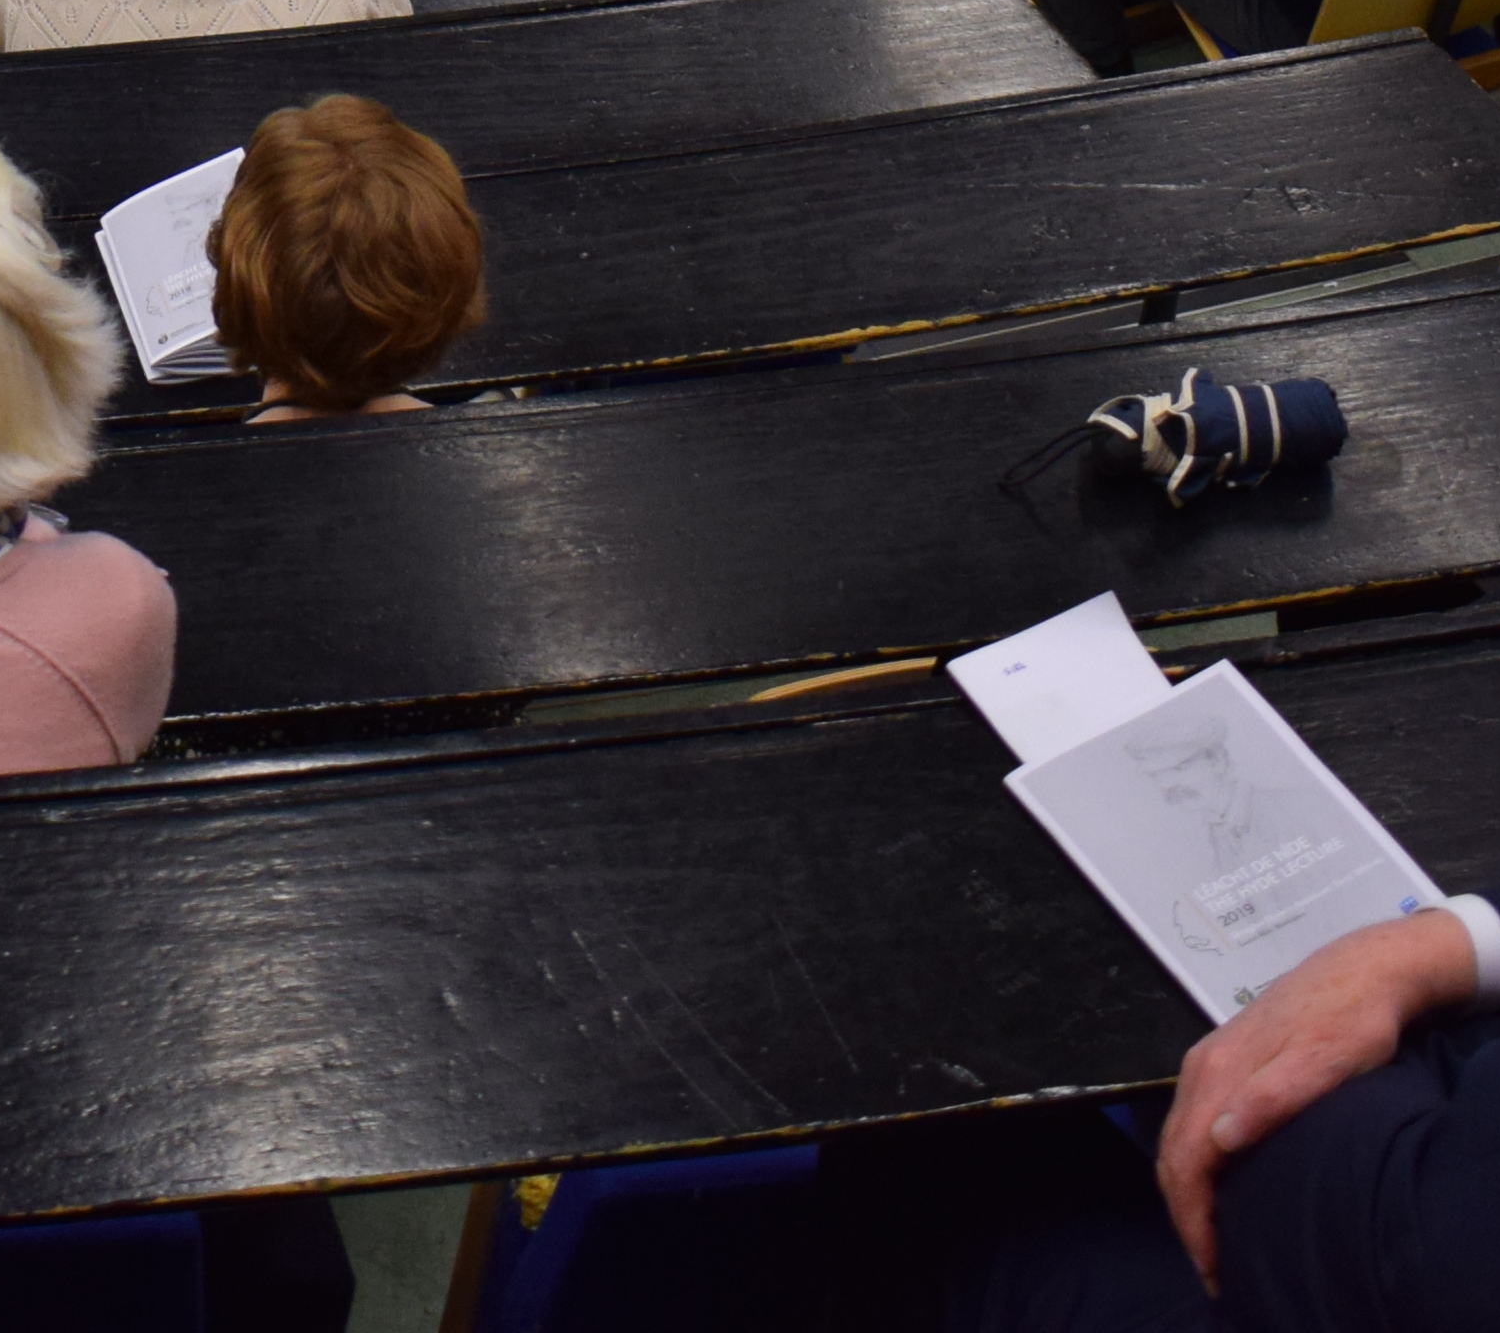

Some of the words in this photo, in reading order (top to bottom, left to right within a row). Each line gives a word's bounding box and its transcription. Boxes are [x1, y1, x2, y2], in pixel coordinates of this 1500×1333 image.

[1236, 870, 1281, 900] HYDE
[1278, 836, 1346, 878] LECTURE
[1217, 902, 1256, 927] 2019
